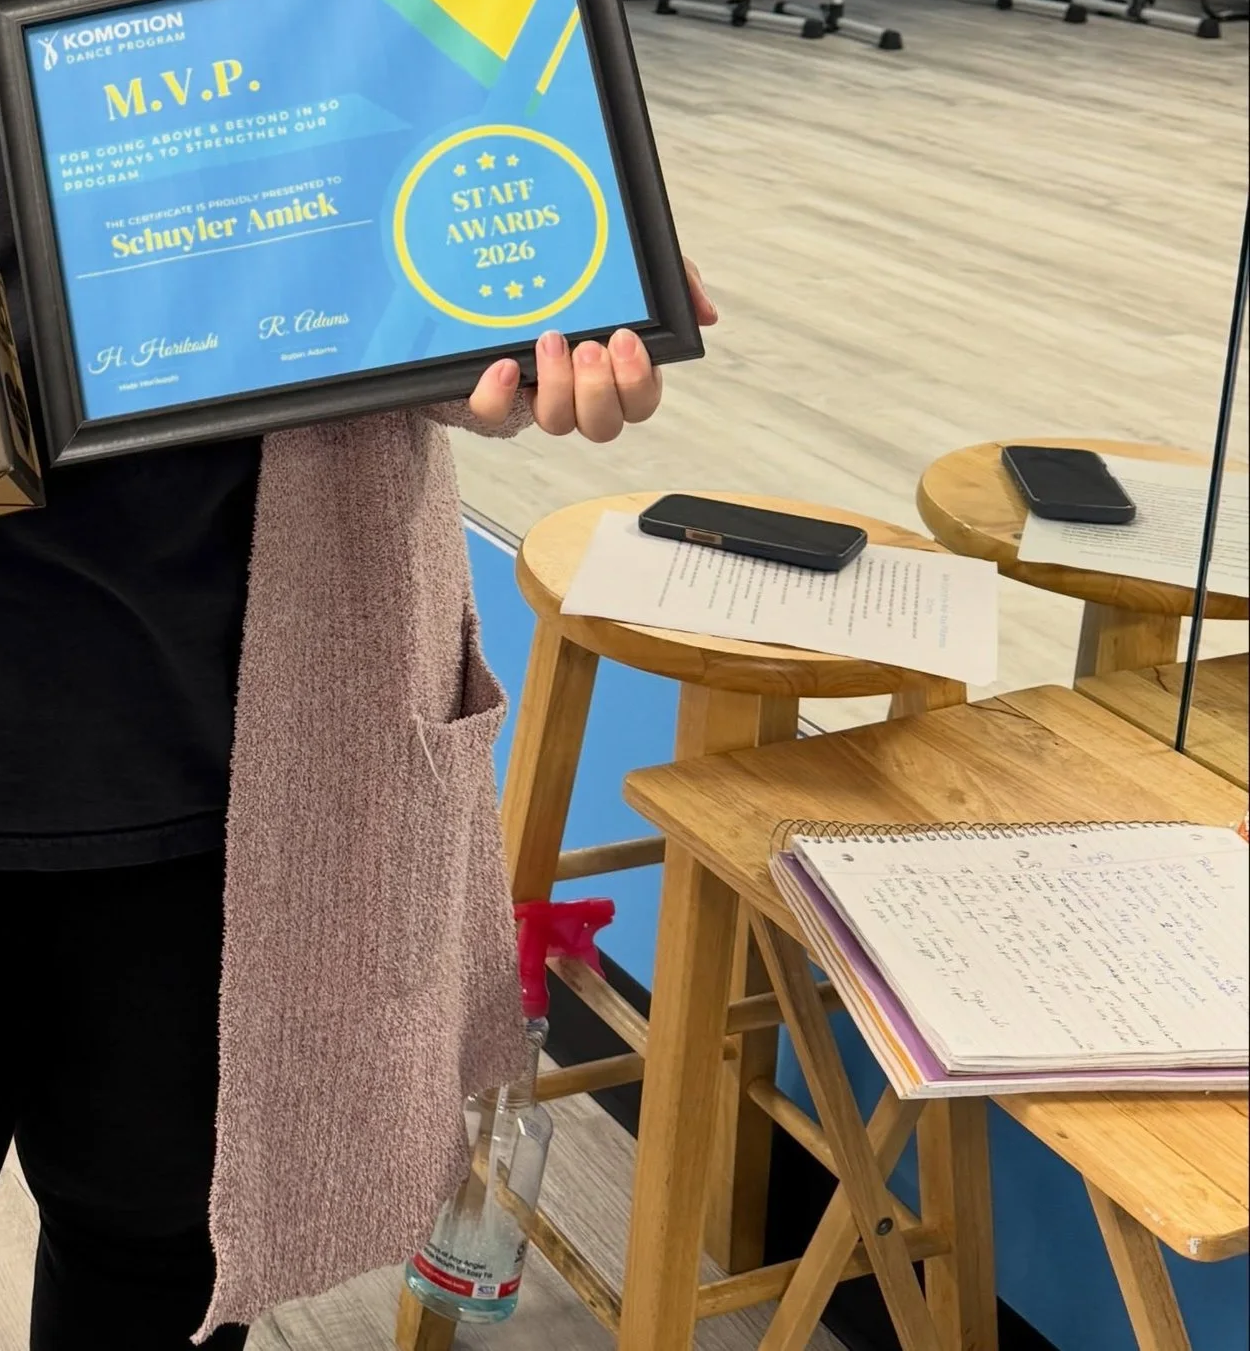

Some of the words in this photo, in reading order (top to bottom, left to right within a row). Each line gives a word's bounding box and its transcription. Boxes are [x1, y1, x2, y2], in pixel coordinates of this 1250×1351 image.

[62, 11, 184, 50] KOMOTION
[66, 45, 112, 65] DANCE
[118, 32, 186, 53] PROGRAM
[103, 59, 260, 121] M.V.P.
[59, 150, 90, 165] FOR
[95, 139, 146, 159] GOING
[151, 126, 203, 146] ABOVE
[225, 110, 290, 131] BEYOND
[296, 106, 312, 119] IN
[318, 99, 340, 113] SO
[61, 162, 104, 178] MANY
[110, 151, 154, 170] WAYS
[159, 146, 179, 160] TO
[185, 126, 288, 154] STRENGTHEN
[293, 115, 327, 133] OUR
[64, 169, 140, 192] PROGRAM
[452, 177, 535, 213] STAFF
[105, 219, 126, 230] THE
[128, 203, 193, 226] CERTIFICATE
[196, 202, 206, 212] IS
[208, 194, 259, 210] PROUDLY
[261, 179, 324, 200] PRESENTED
[326, 174, 342, 186] TO
[111, 216, 238, 259] Schuyler
[247, 192, 339, 233] Amick
[446, 204, 560, 246] AWARDS
[474, 240, 536, 269] 2026
[259, 315, 290, 340] R.
[293, 308, 350, 333] Adams
